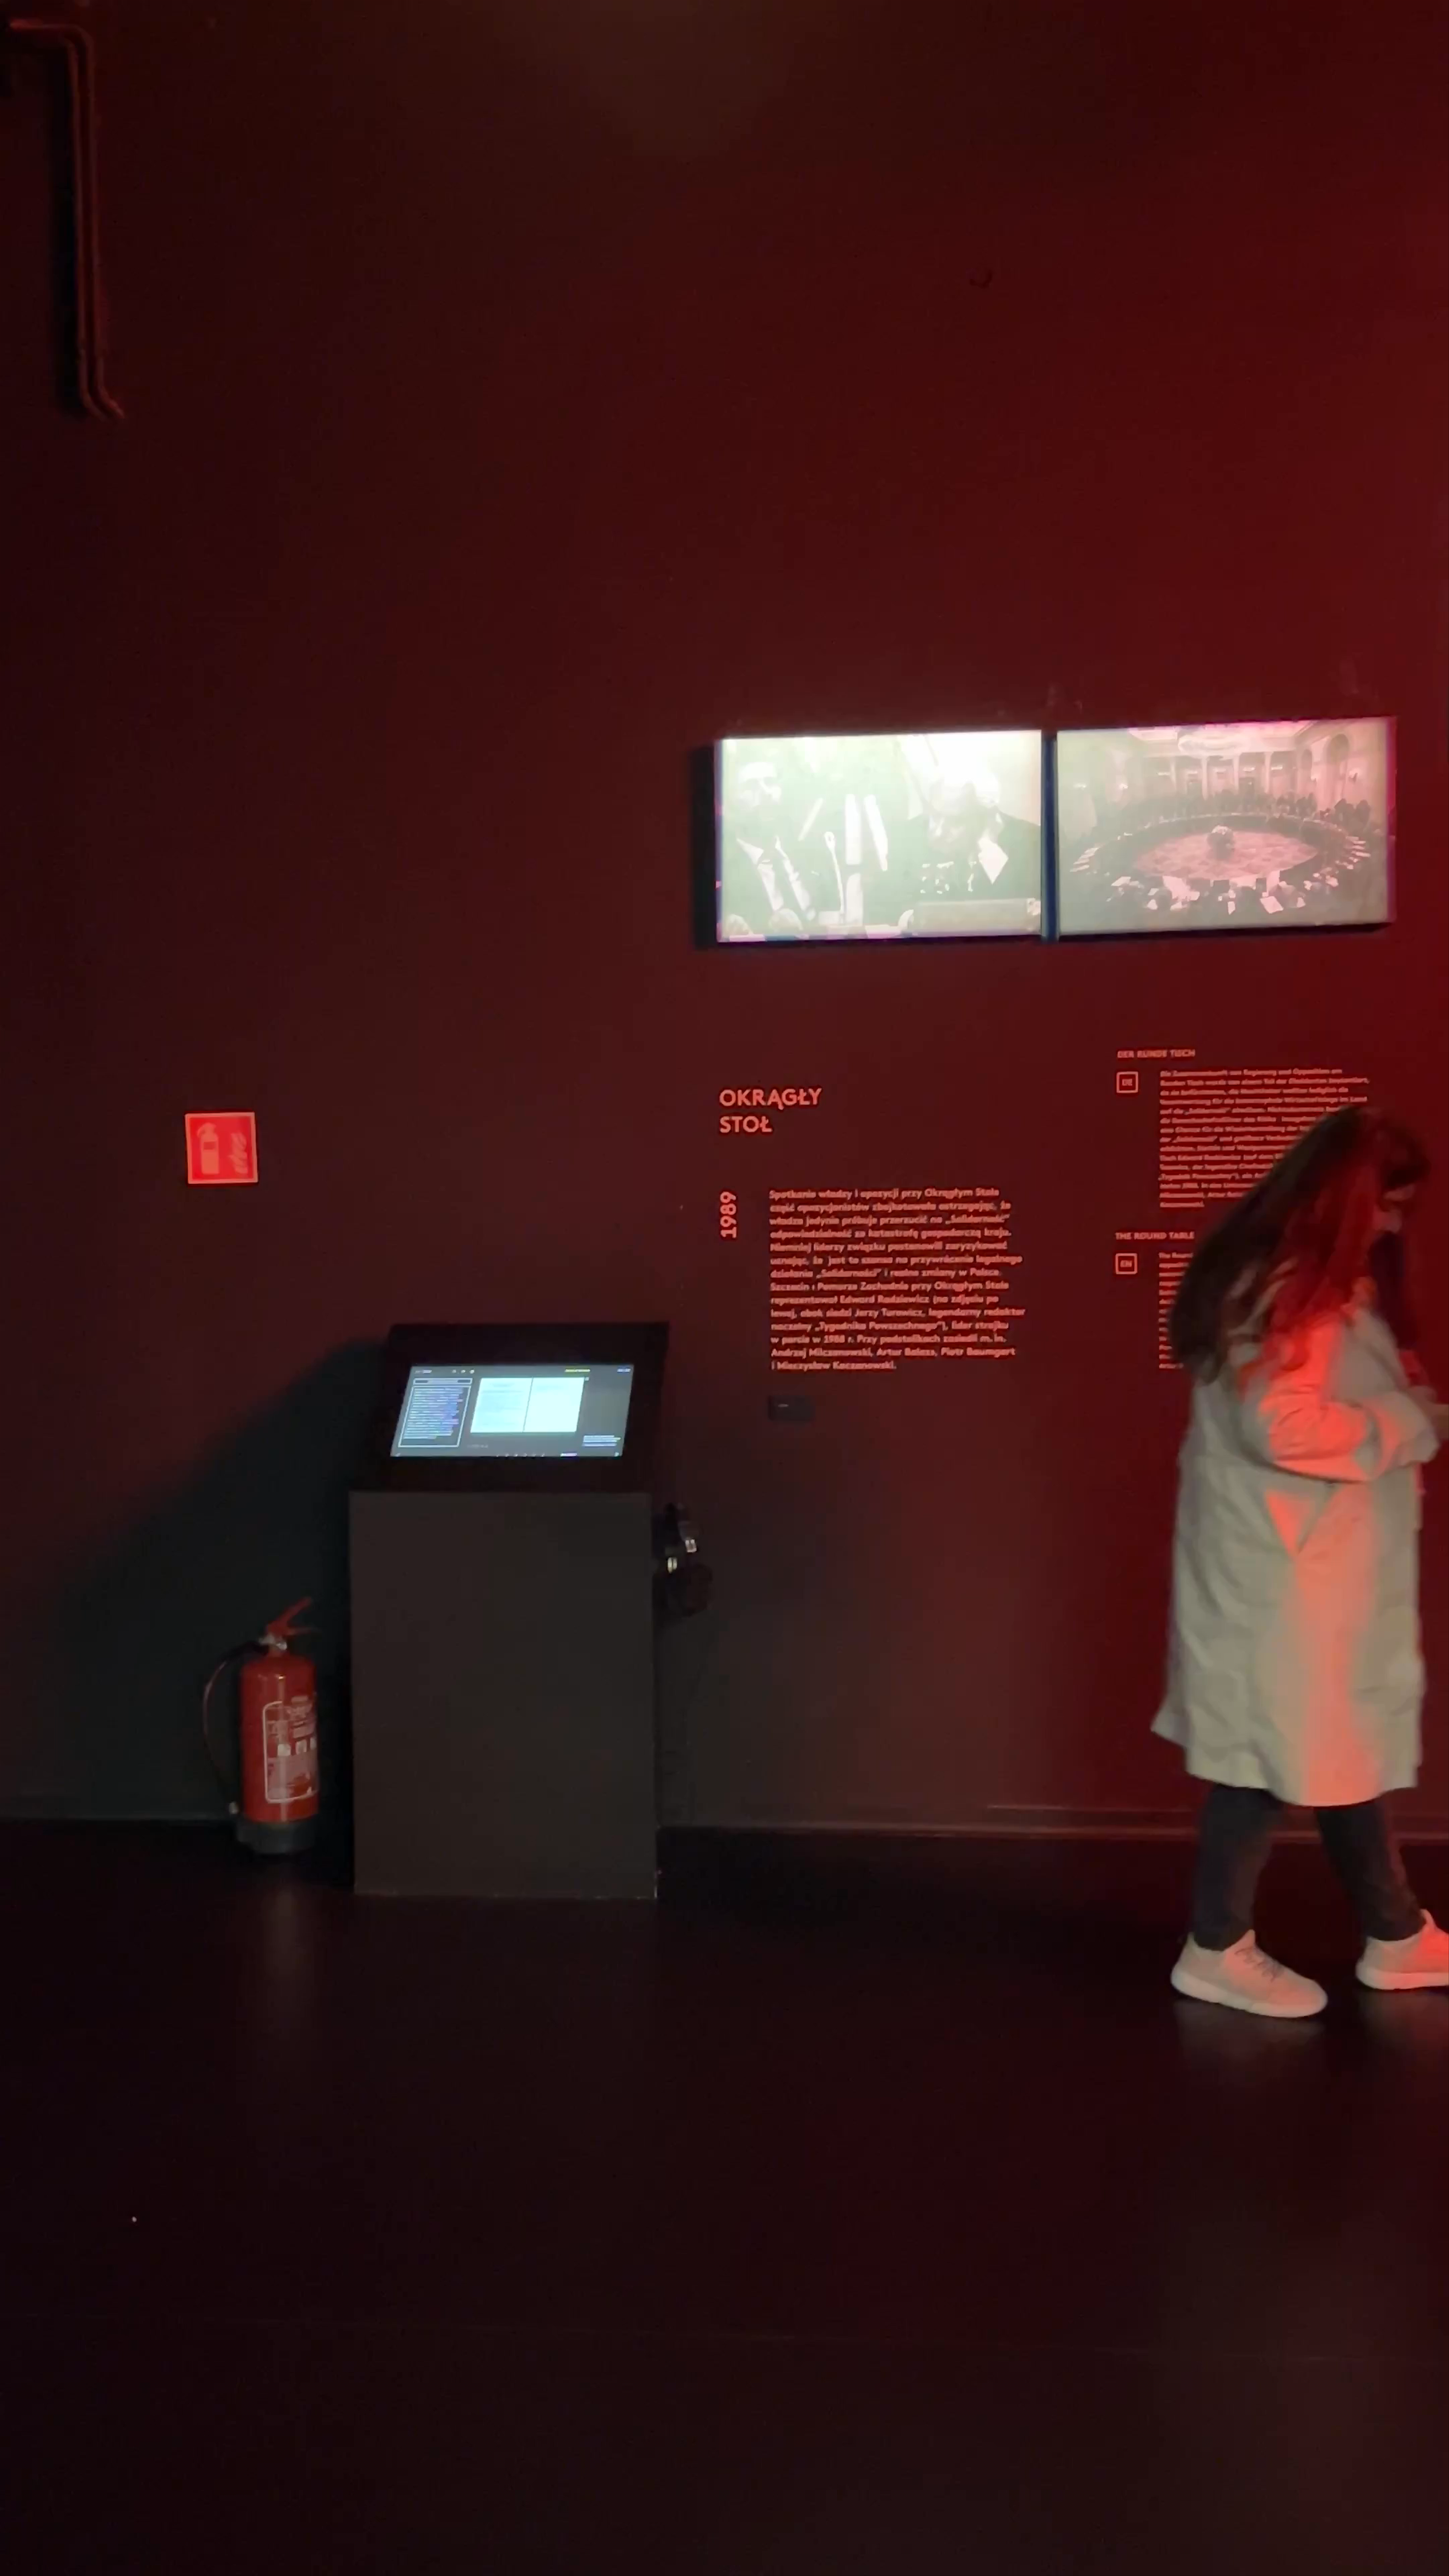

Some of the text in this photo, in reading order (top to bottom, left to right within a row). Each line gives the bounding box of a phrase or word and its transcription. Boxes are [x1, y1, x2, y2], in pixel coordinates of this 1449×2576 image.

[719, 1088, 822, 1110] OKRĄGŁY
[720, 1115, 772, 1133] STOŁ
[720, 1191, 737, 1238] 1989
